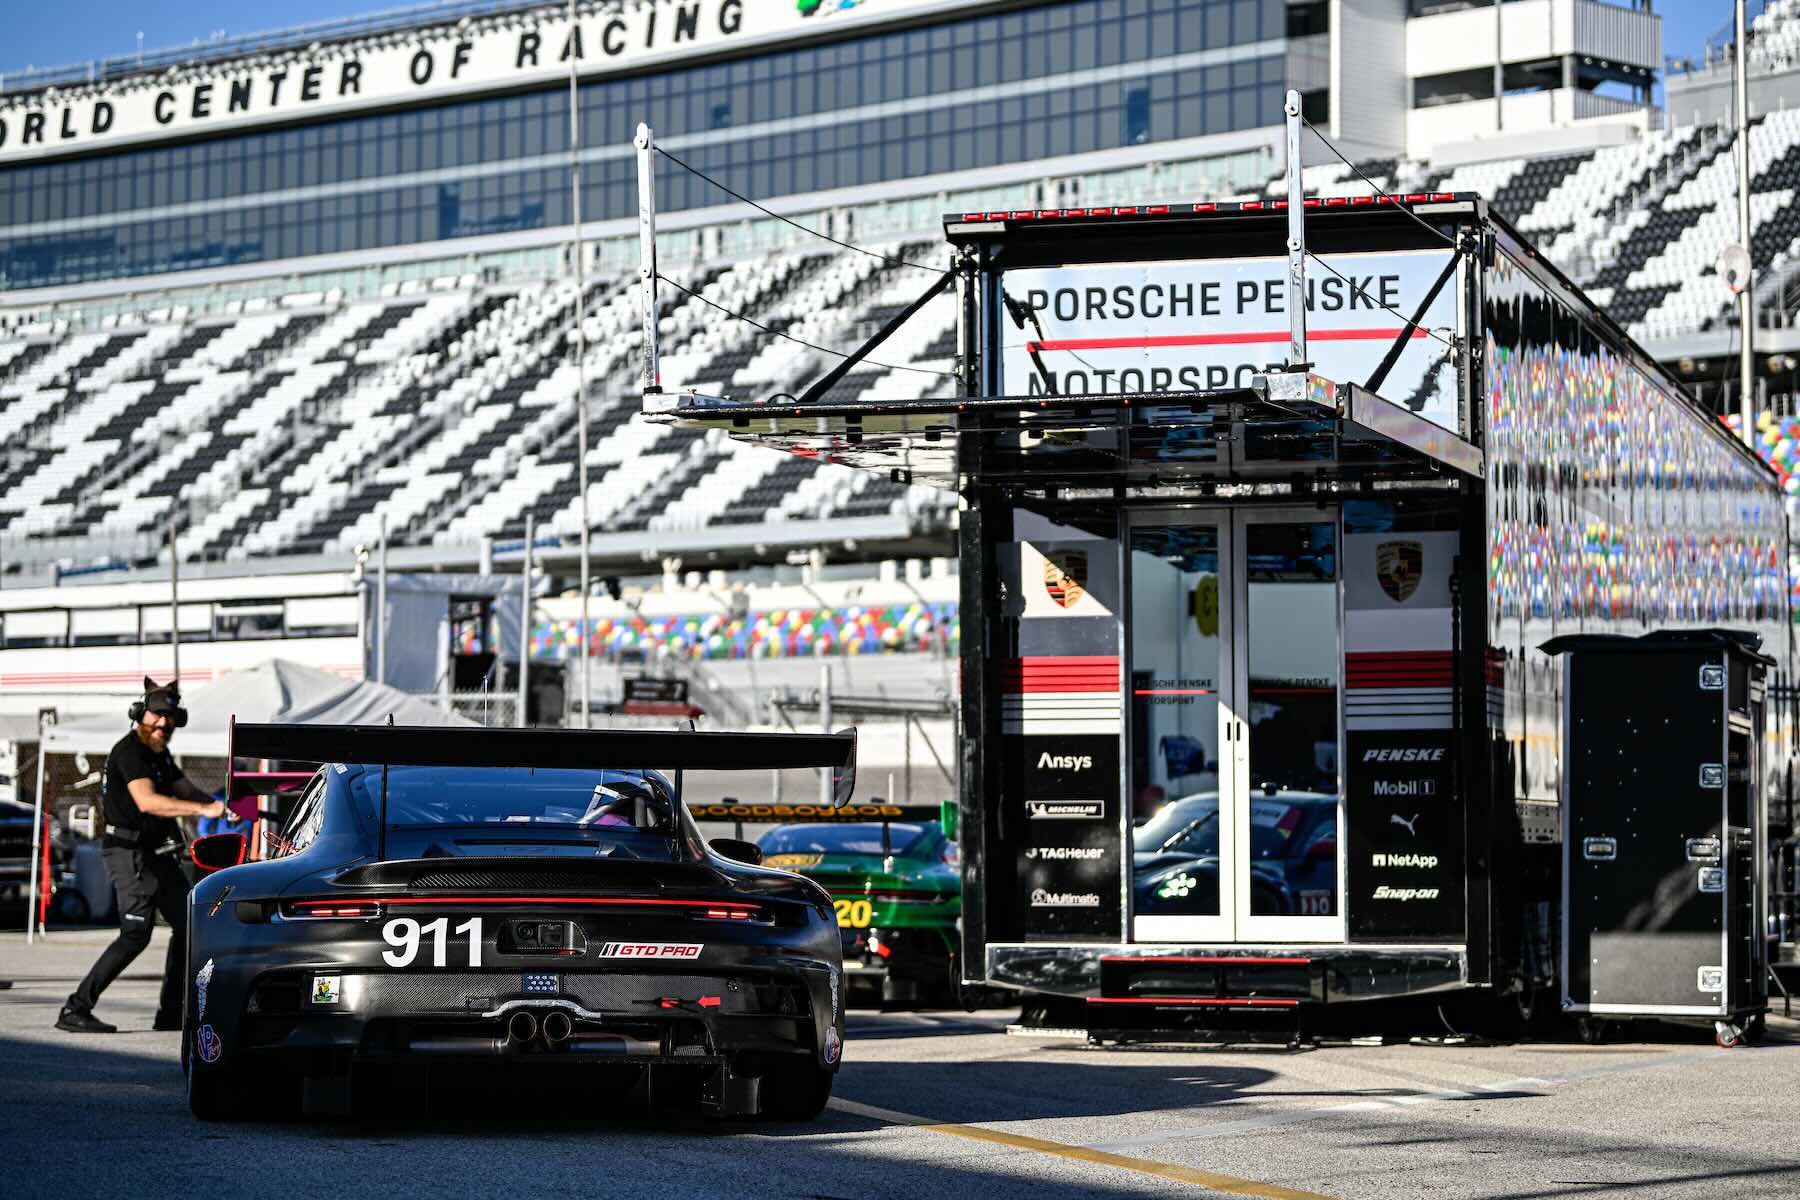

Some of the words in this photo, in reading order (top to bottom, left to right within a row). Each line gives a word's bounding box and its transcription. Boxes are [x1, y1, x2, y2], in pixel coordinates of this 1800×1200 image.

[155, 62, 362, 124] CENTER
[410, 43, 472, 85] OF
[516, 0, 742, 68] RACING
[1028, 282, 1221, 321] PORSCHE
[1037, 751, 1092, 771] Ansys
[1362, 748, 1445, 761] PENSKE
[1374, 780, 1417, 795] Mobil
[1047, 805, 1097, 814] MICHELIN
[1387, 854, 1438, 868] NetApp
[1046, 893, 1100, 905] Multimatic
[1372, 885, 1440, 900] Snap-on
[382, 917, 482, 967] 911
[620, 945, 658, 956] GTD
[660, 946, 699, 956] PRO
